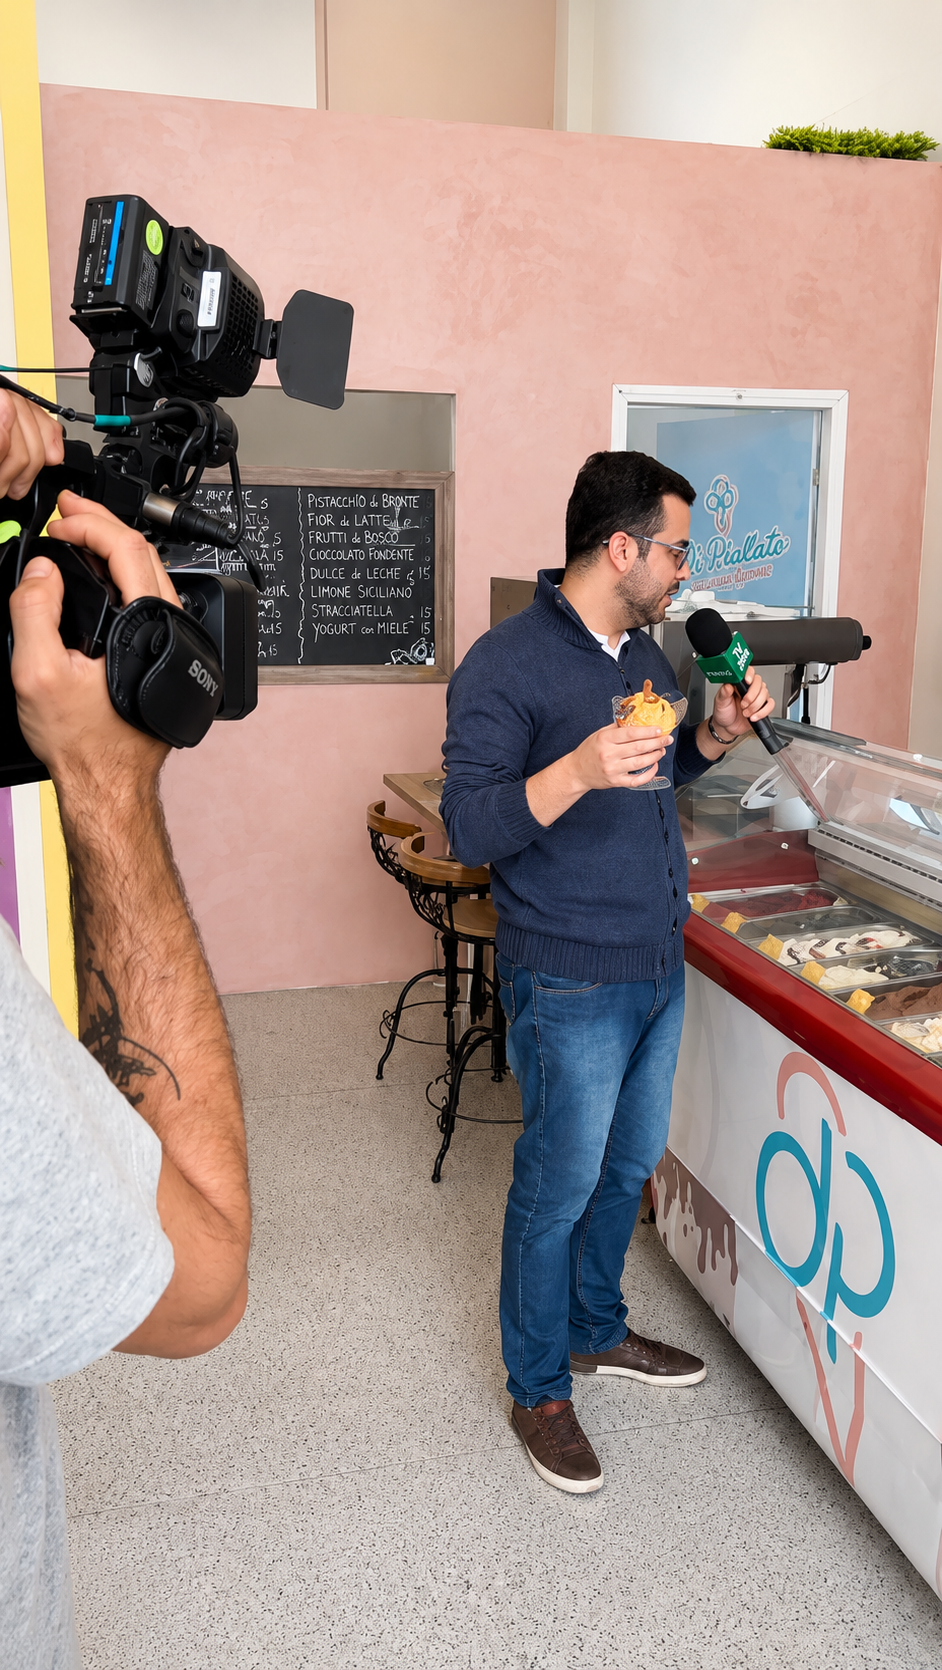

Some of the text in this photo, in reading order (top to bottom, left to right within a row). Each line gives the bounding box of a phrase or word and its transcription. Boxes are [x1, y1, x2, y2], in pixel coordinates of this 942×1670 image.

[307, 493, 367, 509] PISTACCHIO
[382, 493, 420, 509] BRONTE
[307, 512, 336, 527] FIOR
[354, 513, 391, 527] LATTE
[308, 530, 347, 544] FRUTTI
[364, 529, 399, 544] BOSCO
[309, 548, 366, 561] CIOCCOLATO
[368, 547, 415, 561] FONDENTE
[310, 567, 346, 580] DULCE
[366, 567, 401, 580] LECHE
[310, 584, 413, 599] LIMONE SICILIANO
[311, 603, 432, 618] STRACCIATELLA 15
[312, 622, 357, 643] YOGURT
[377, 621, 409, 635] MIELE
[420, 621, 432, 635] 15
[732, 642, 744, 661] TV
[187, 659, 219, 697] SONY
